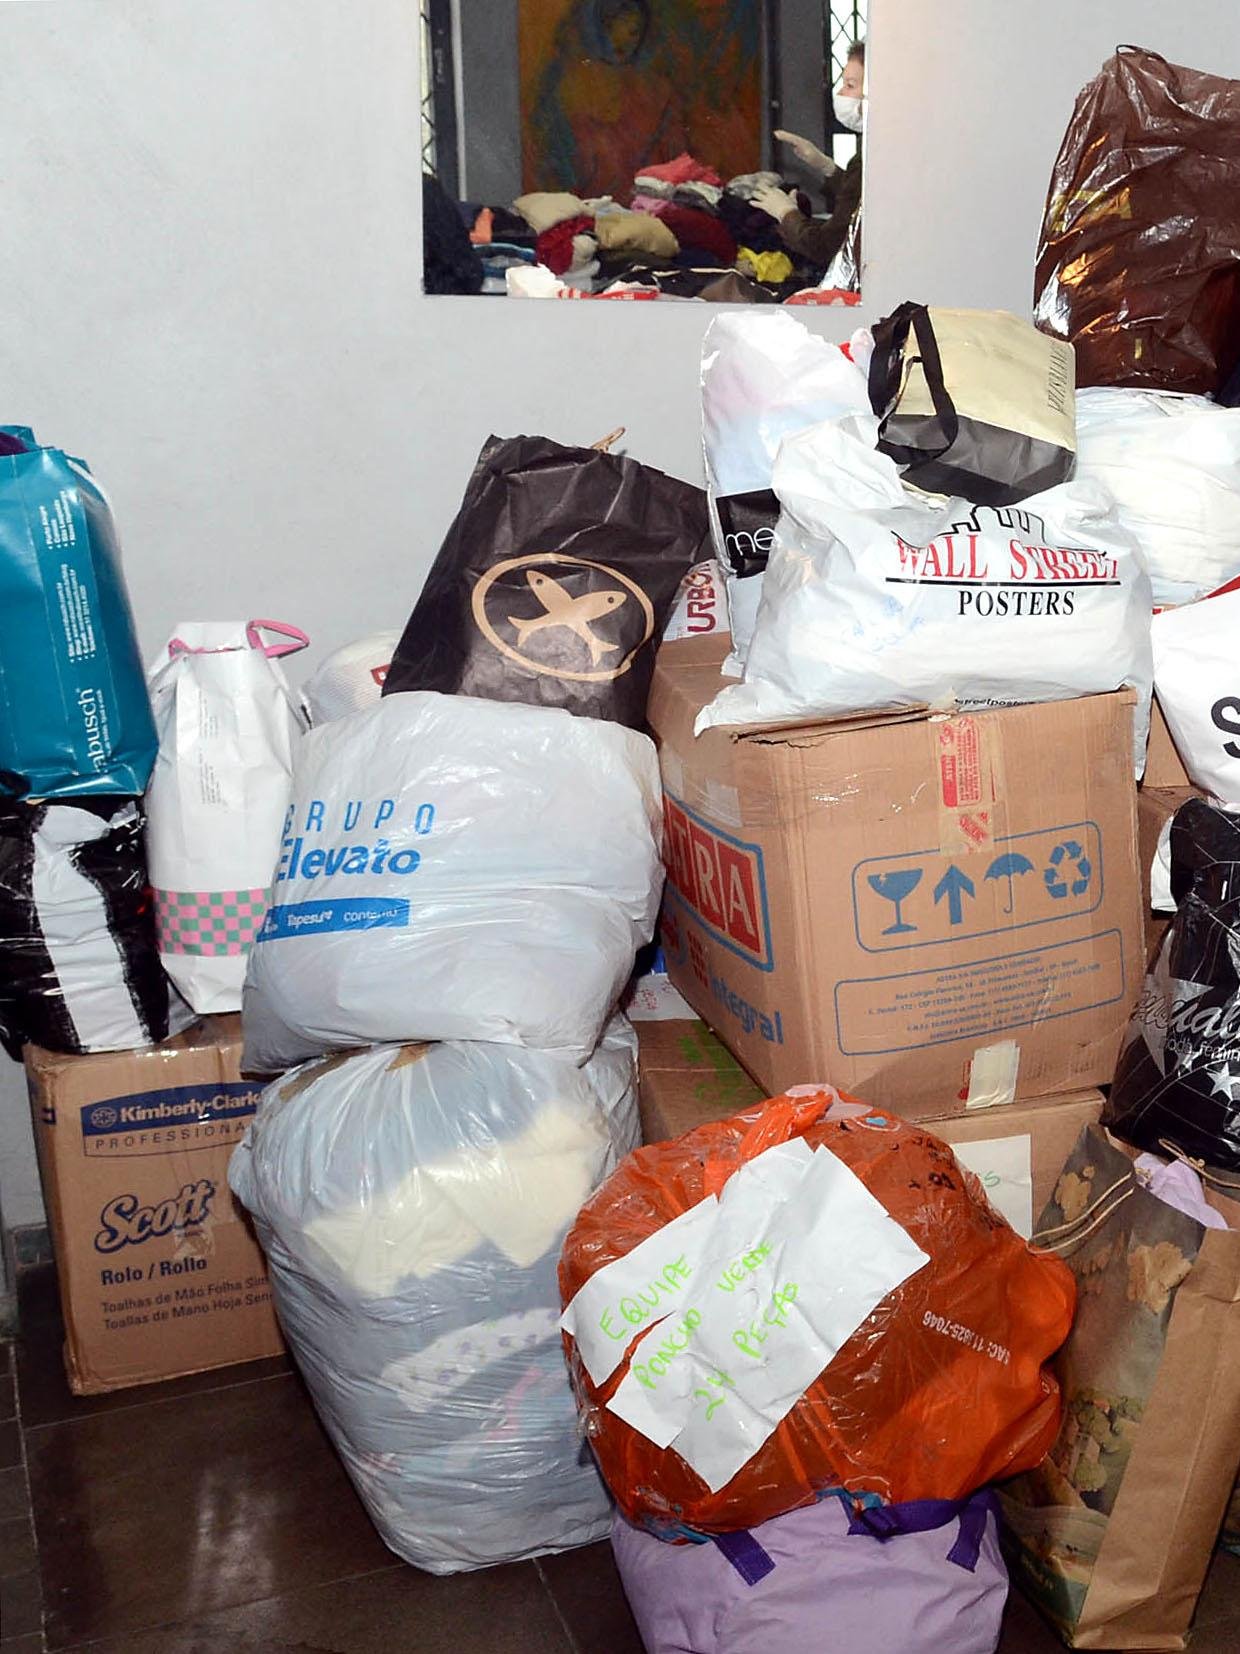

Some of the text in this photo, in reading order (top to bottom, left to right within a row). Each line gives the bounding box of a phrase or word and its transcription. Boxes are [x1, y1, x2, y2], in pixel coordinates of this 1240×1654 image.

[897, 535, 1118, 580] WALL STREET
[957, 590, 1075, 617] POSTERS
[78, 690, 108, 773] abusch
[277, 837, 421, 882] Elevato
[95, 1121, 247, 1150] PROFESSIONA
[94, 1179, 217, 1254] Scott
[101, 1267, 143, 1286] Rolo
[160, 1257, 208, 1277] Rollo
[102, 1298, 152, 1314] Toalhas
[155, 1293, 171, 1306] de
[153, 1310, 169, 1323] de
[172, 1304, 210, 1319] Mano
[599, 1254, 692, 1341] EQUIPE
[633, 1308, 701, 1389] PONCHO
